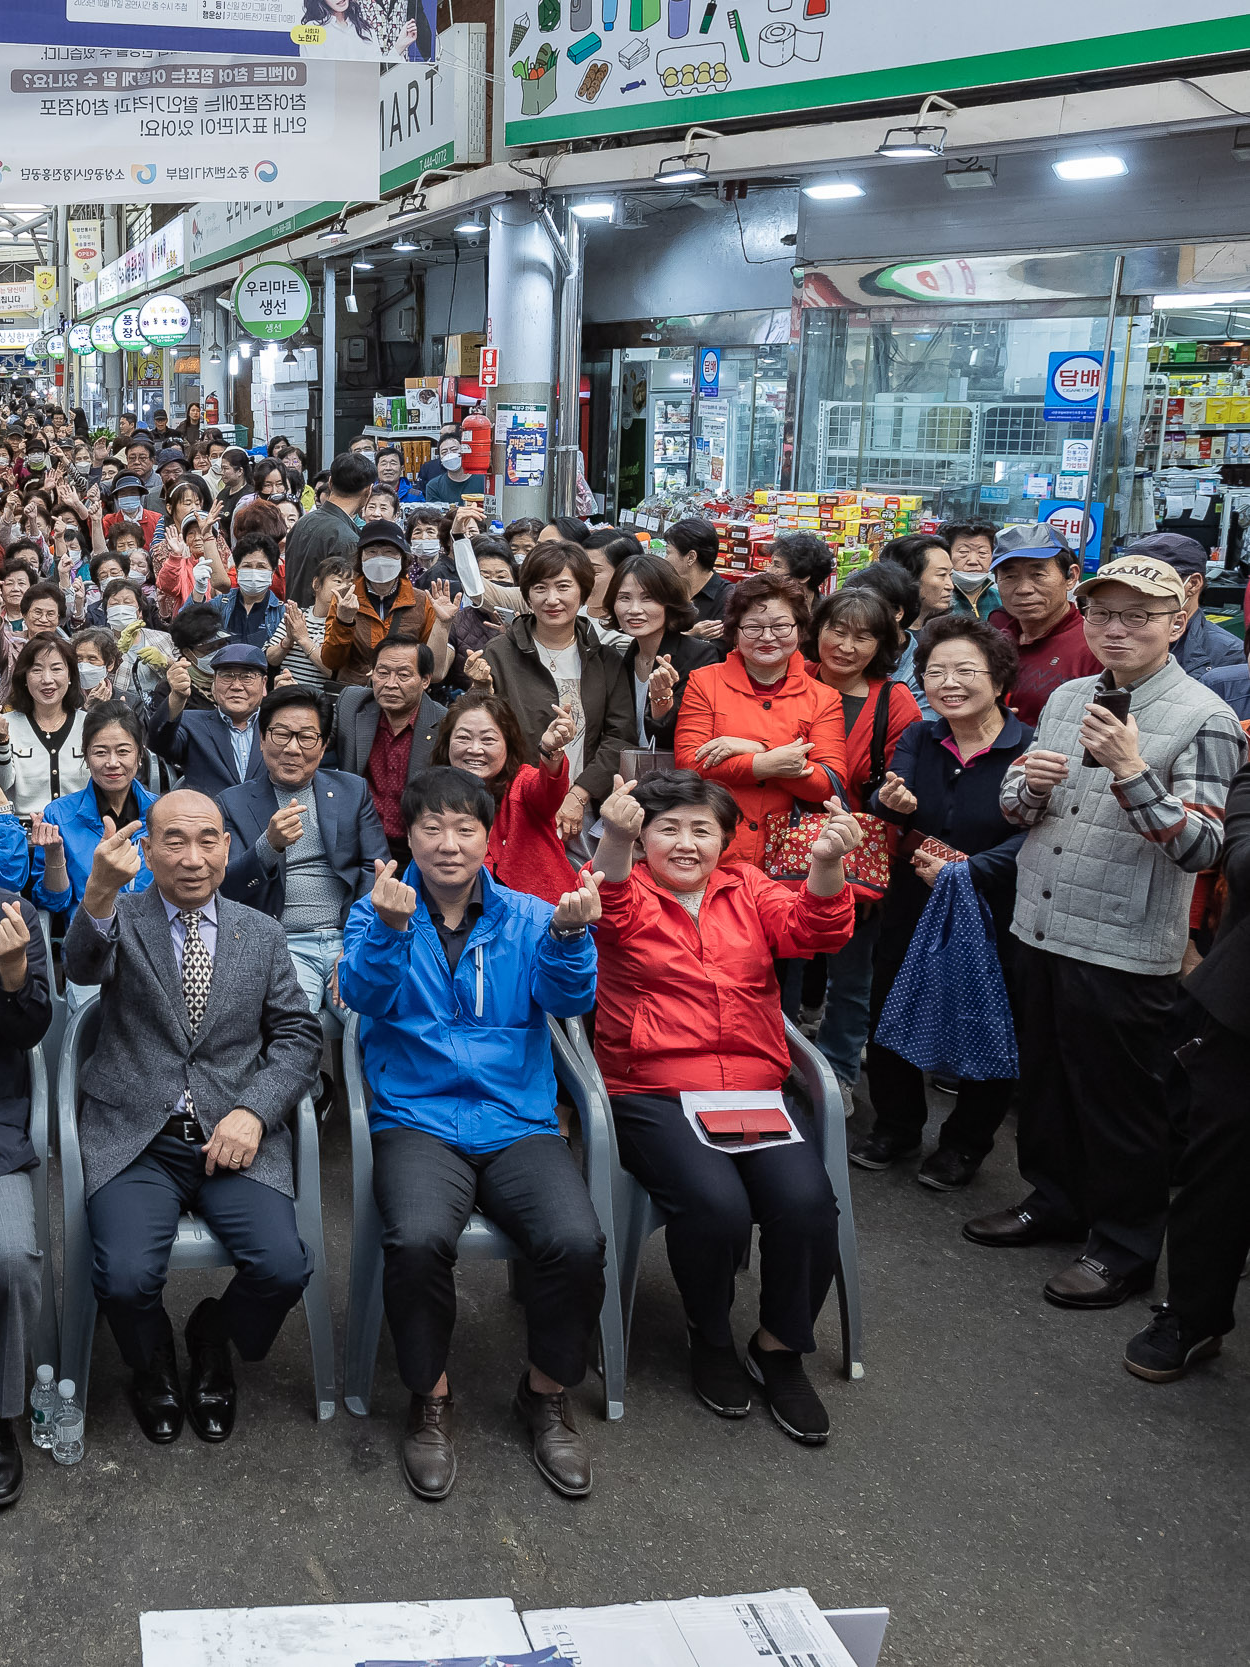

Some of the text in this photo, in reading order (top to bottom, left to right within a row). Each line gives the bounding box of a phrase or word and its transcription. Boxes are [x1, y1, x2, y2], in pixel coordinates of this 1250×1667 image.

[245, 280, 300, 297] 우리마트
[259, 299, 287, 316] 생선
[265, 323, 282, 333] 생선
[1059, 369, 1100, 387] 담배
